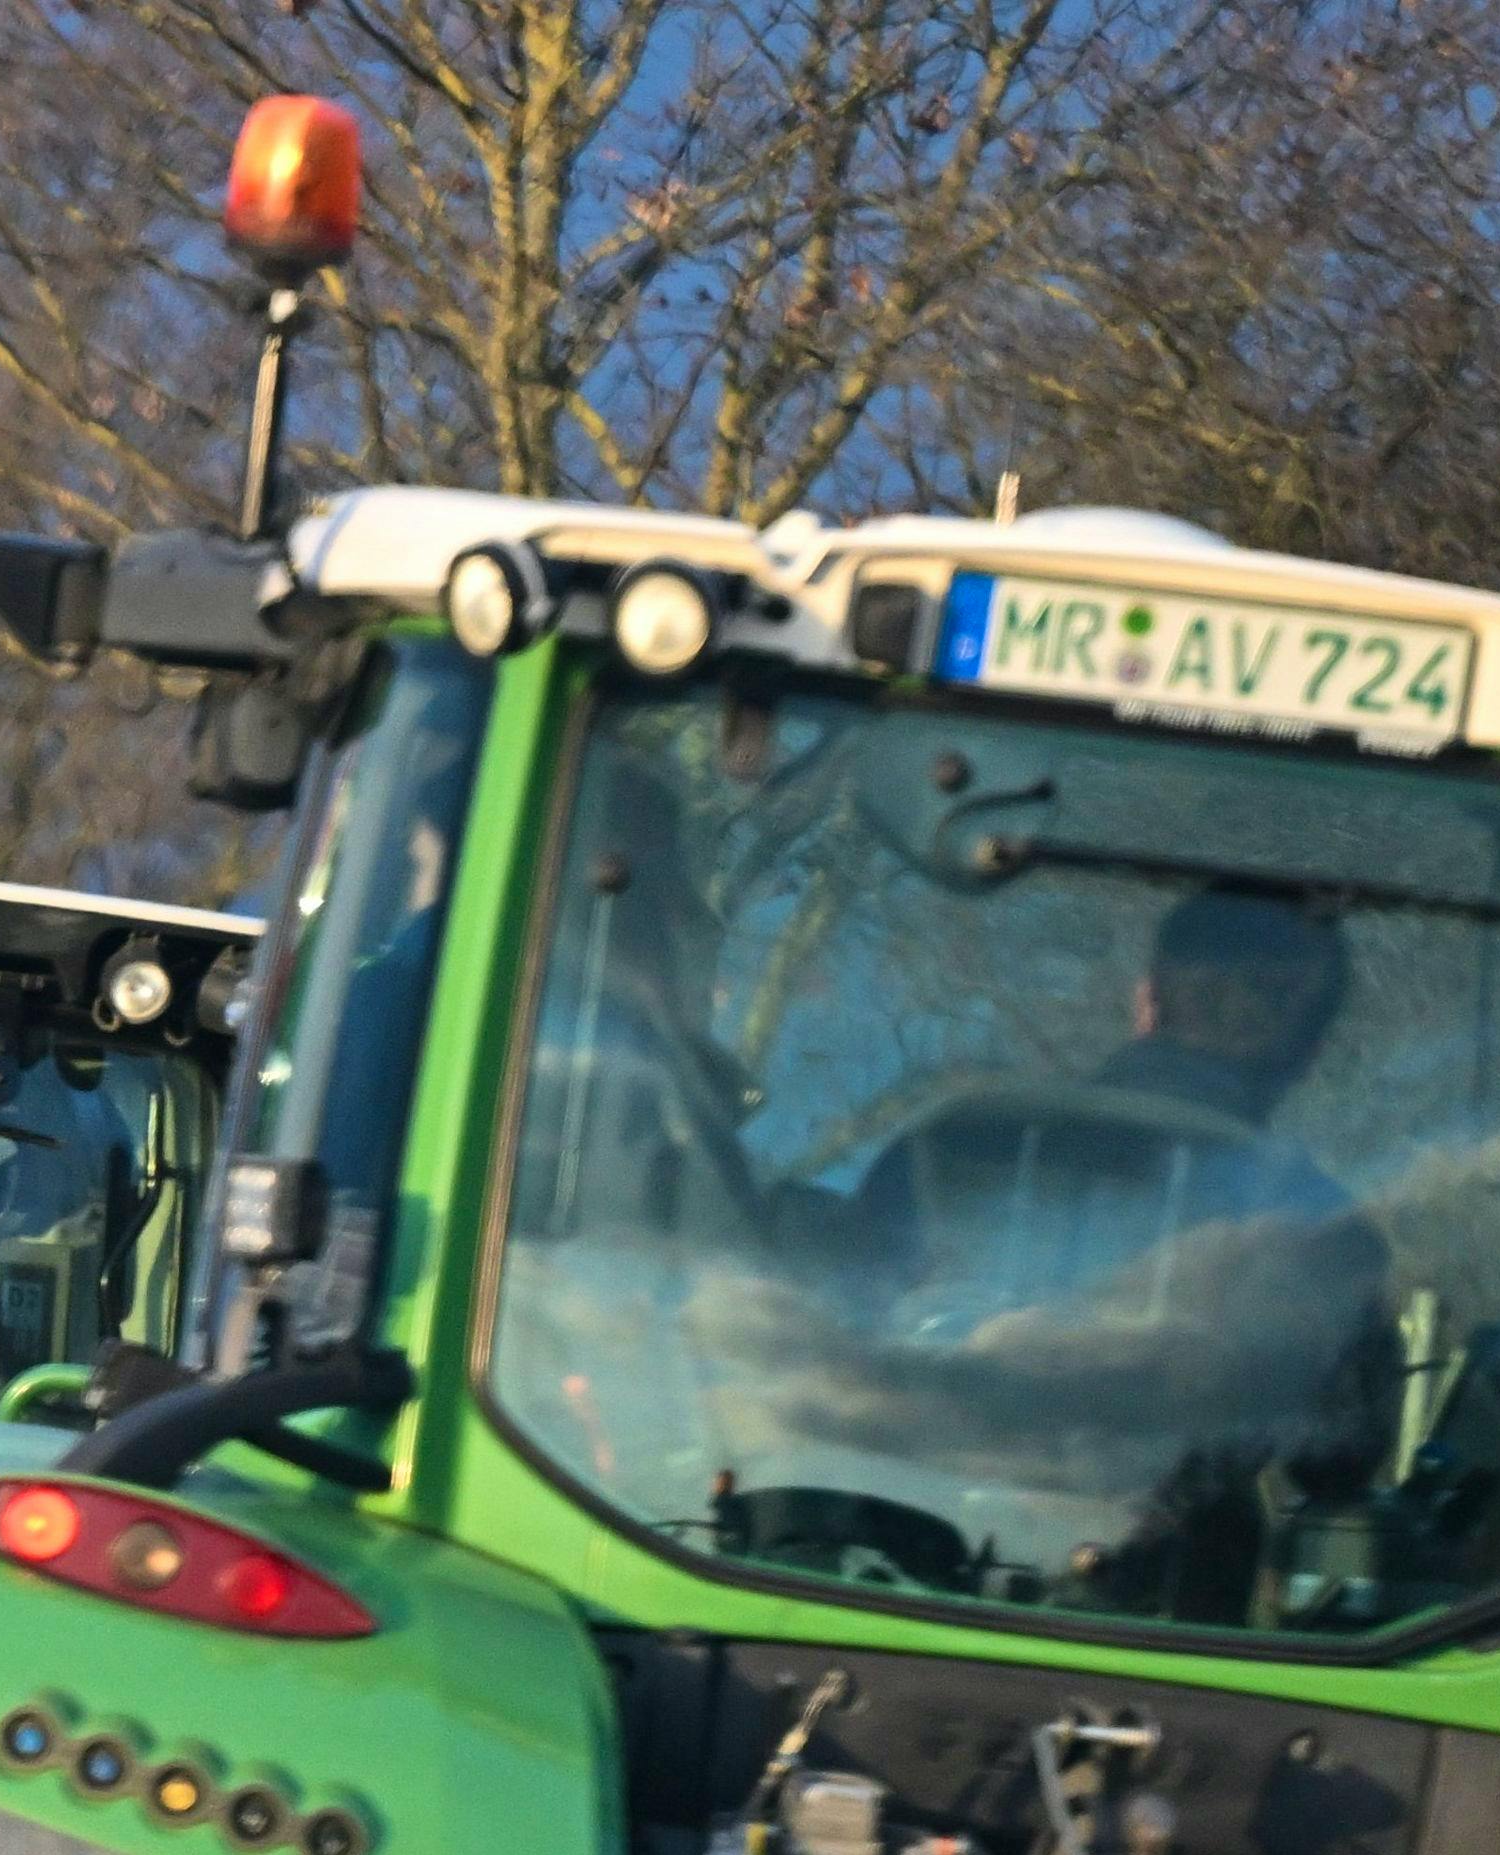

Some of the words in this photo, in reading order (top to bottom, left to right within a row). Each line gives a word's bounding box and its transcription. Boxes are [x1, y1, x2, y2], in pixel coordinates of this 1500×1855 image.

[994, 595, 1106, 680] MR
[1165, 614, 1278, 695] AV
[1303, 629, 1450, 718] 724
